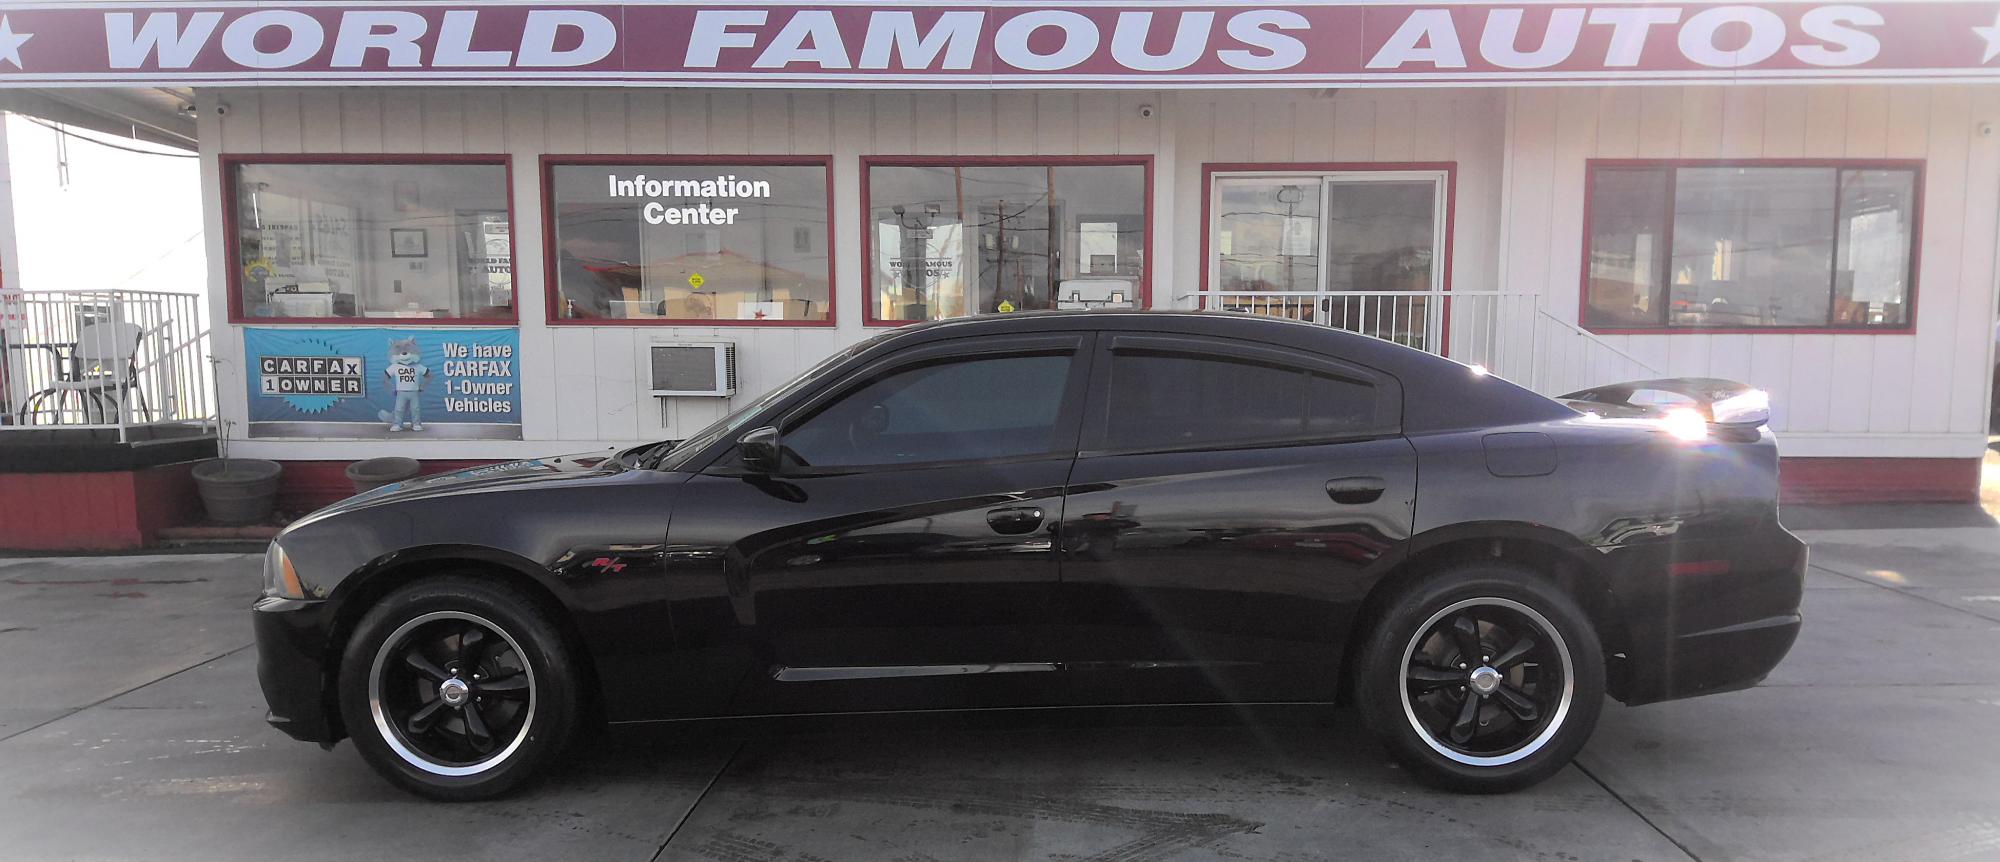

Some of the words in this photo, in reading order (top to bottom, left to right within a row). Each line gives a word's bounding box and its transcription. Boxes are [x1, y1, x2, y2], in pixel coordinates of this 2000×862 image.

[103, 9, 617, 70] WORLD
[683, 9, 1312, 72] FAMOUS
[1364, 5, 1885, 70] AUTOS
[608, 174, 770, 198] Information
[643, 201, 739, 225] Center
[442, 342, 469, 358] We
[473, 342, 512, 358] have
[262, 359, 361, 375] CARFAX
[398, 367, 416, 375] CAR
[443, 360, 512, 377] CARFAX
[265, 378, 275, 392] 1
[280, 378, 361, 393] OWNER
[399, 375, 416, 383] FOX
[445, 379, 513, 396] 1-Owner
[445, 397, 511, 414] Vehicles
